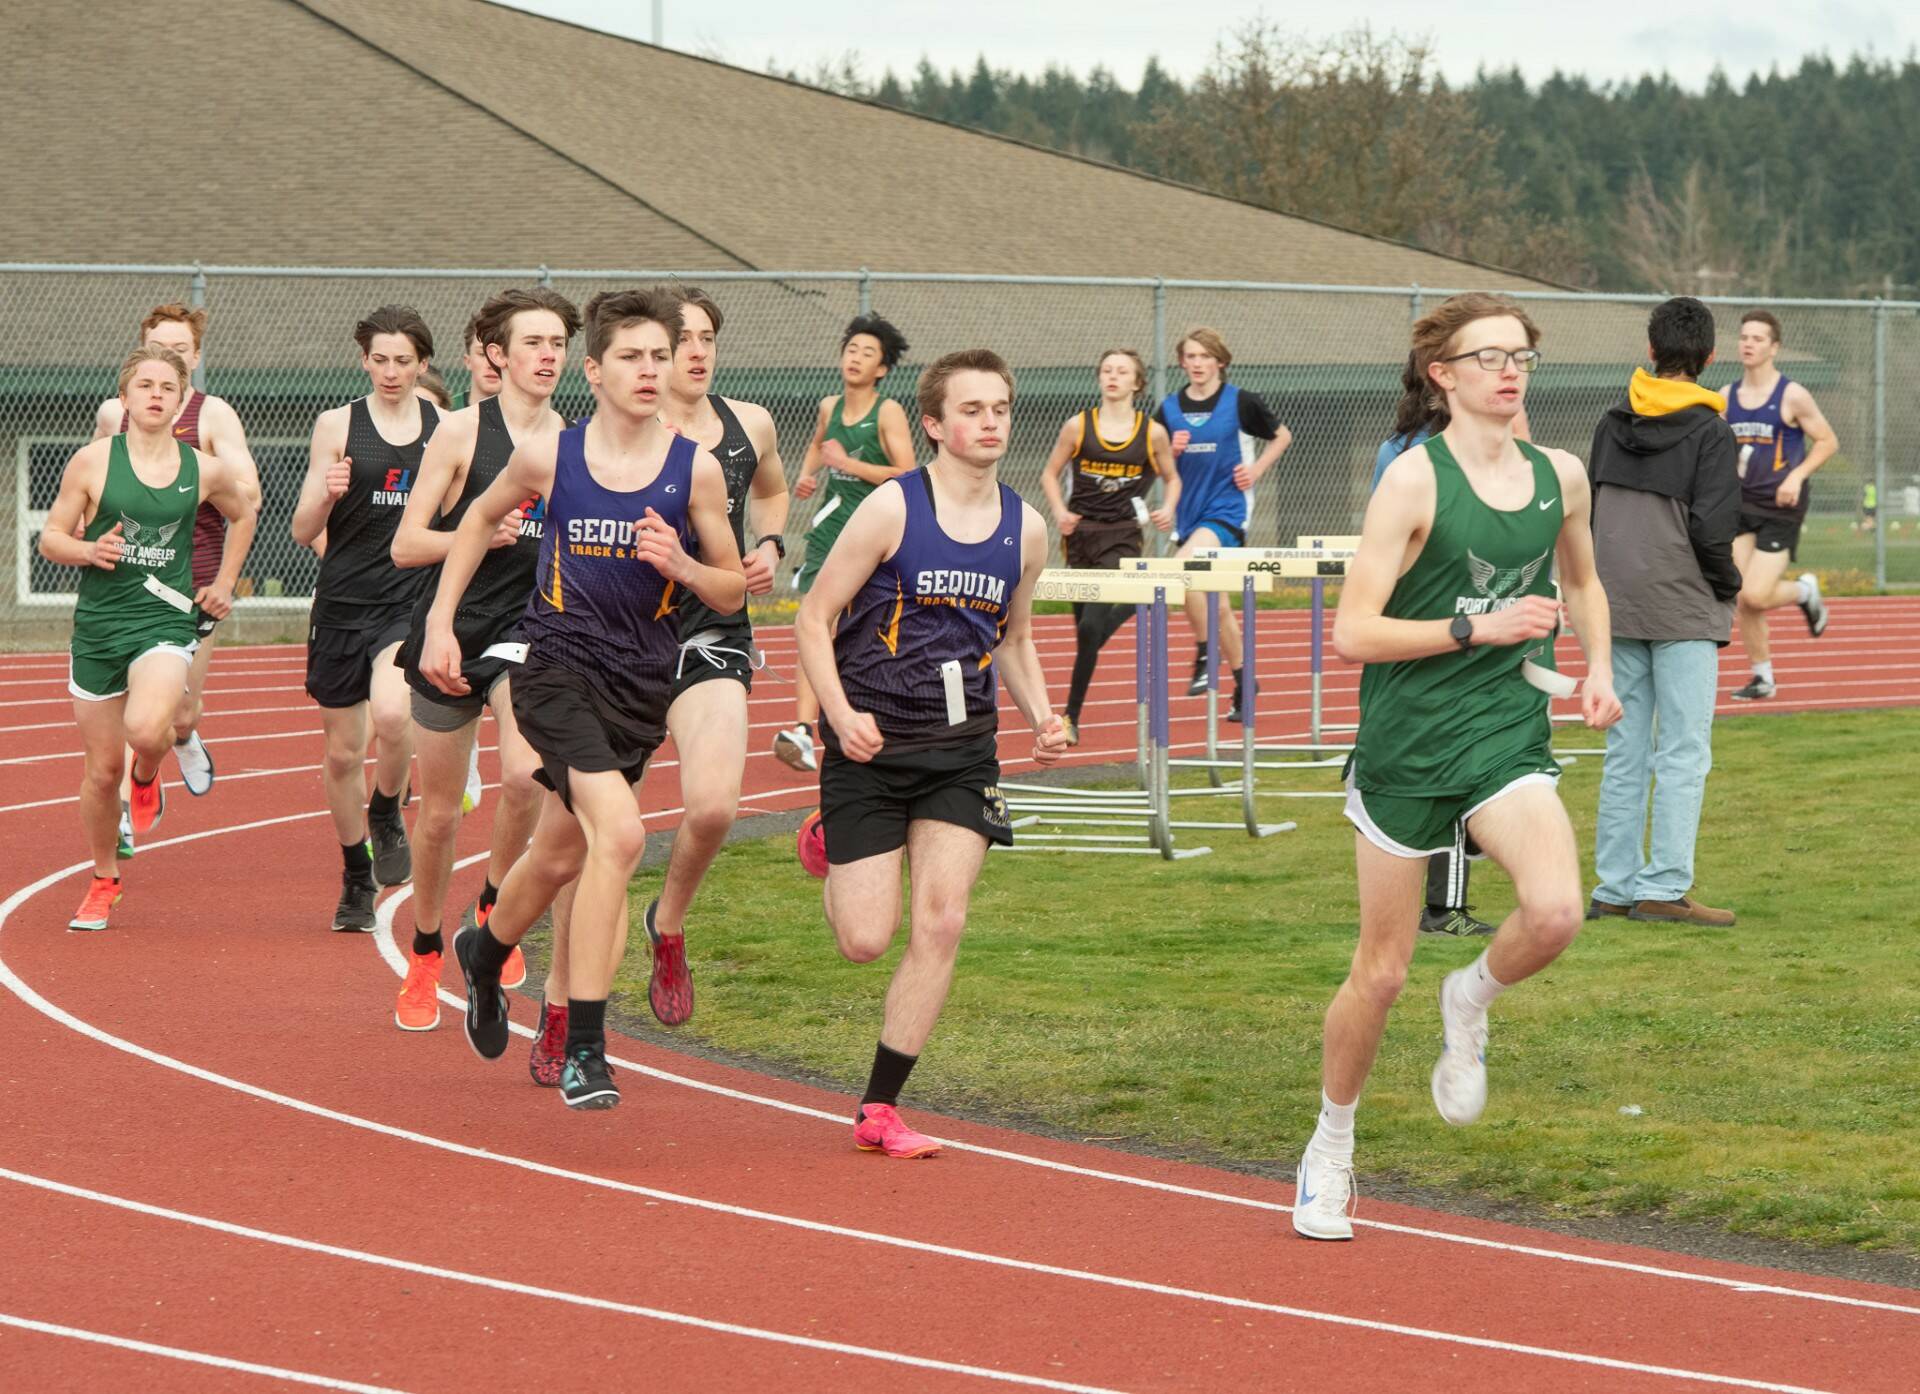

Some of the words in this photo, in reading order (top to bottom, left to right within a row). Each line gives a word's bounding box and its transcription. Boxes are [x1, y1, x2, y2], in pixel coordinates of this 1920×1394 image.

[372, 490, 409, 506] RIVAL
[518, 519, 545, 538] VAL
[567, 518, 642, 546] SEQU
[137, 545, 176, 561] ANGELES
[568, 544, 612, 557] TRACK
[615, 547, 626, 559] &
[120, 555, 167, 568] TRACK
[916, 569, 1005, 604] SEQUIM
[915, 596, 957, 608] TRACK
[959, 597, 967, 609] &
[970, 599, 1001, 615] FIELD
[1454, 596, 1491, 615] PORT
